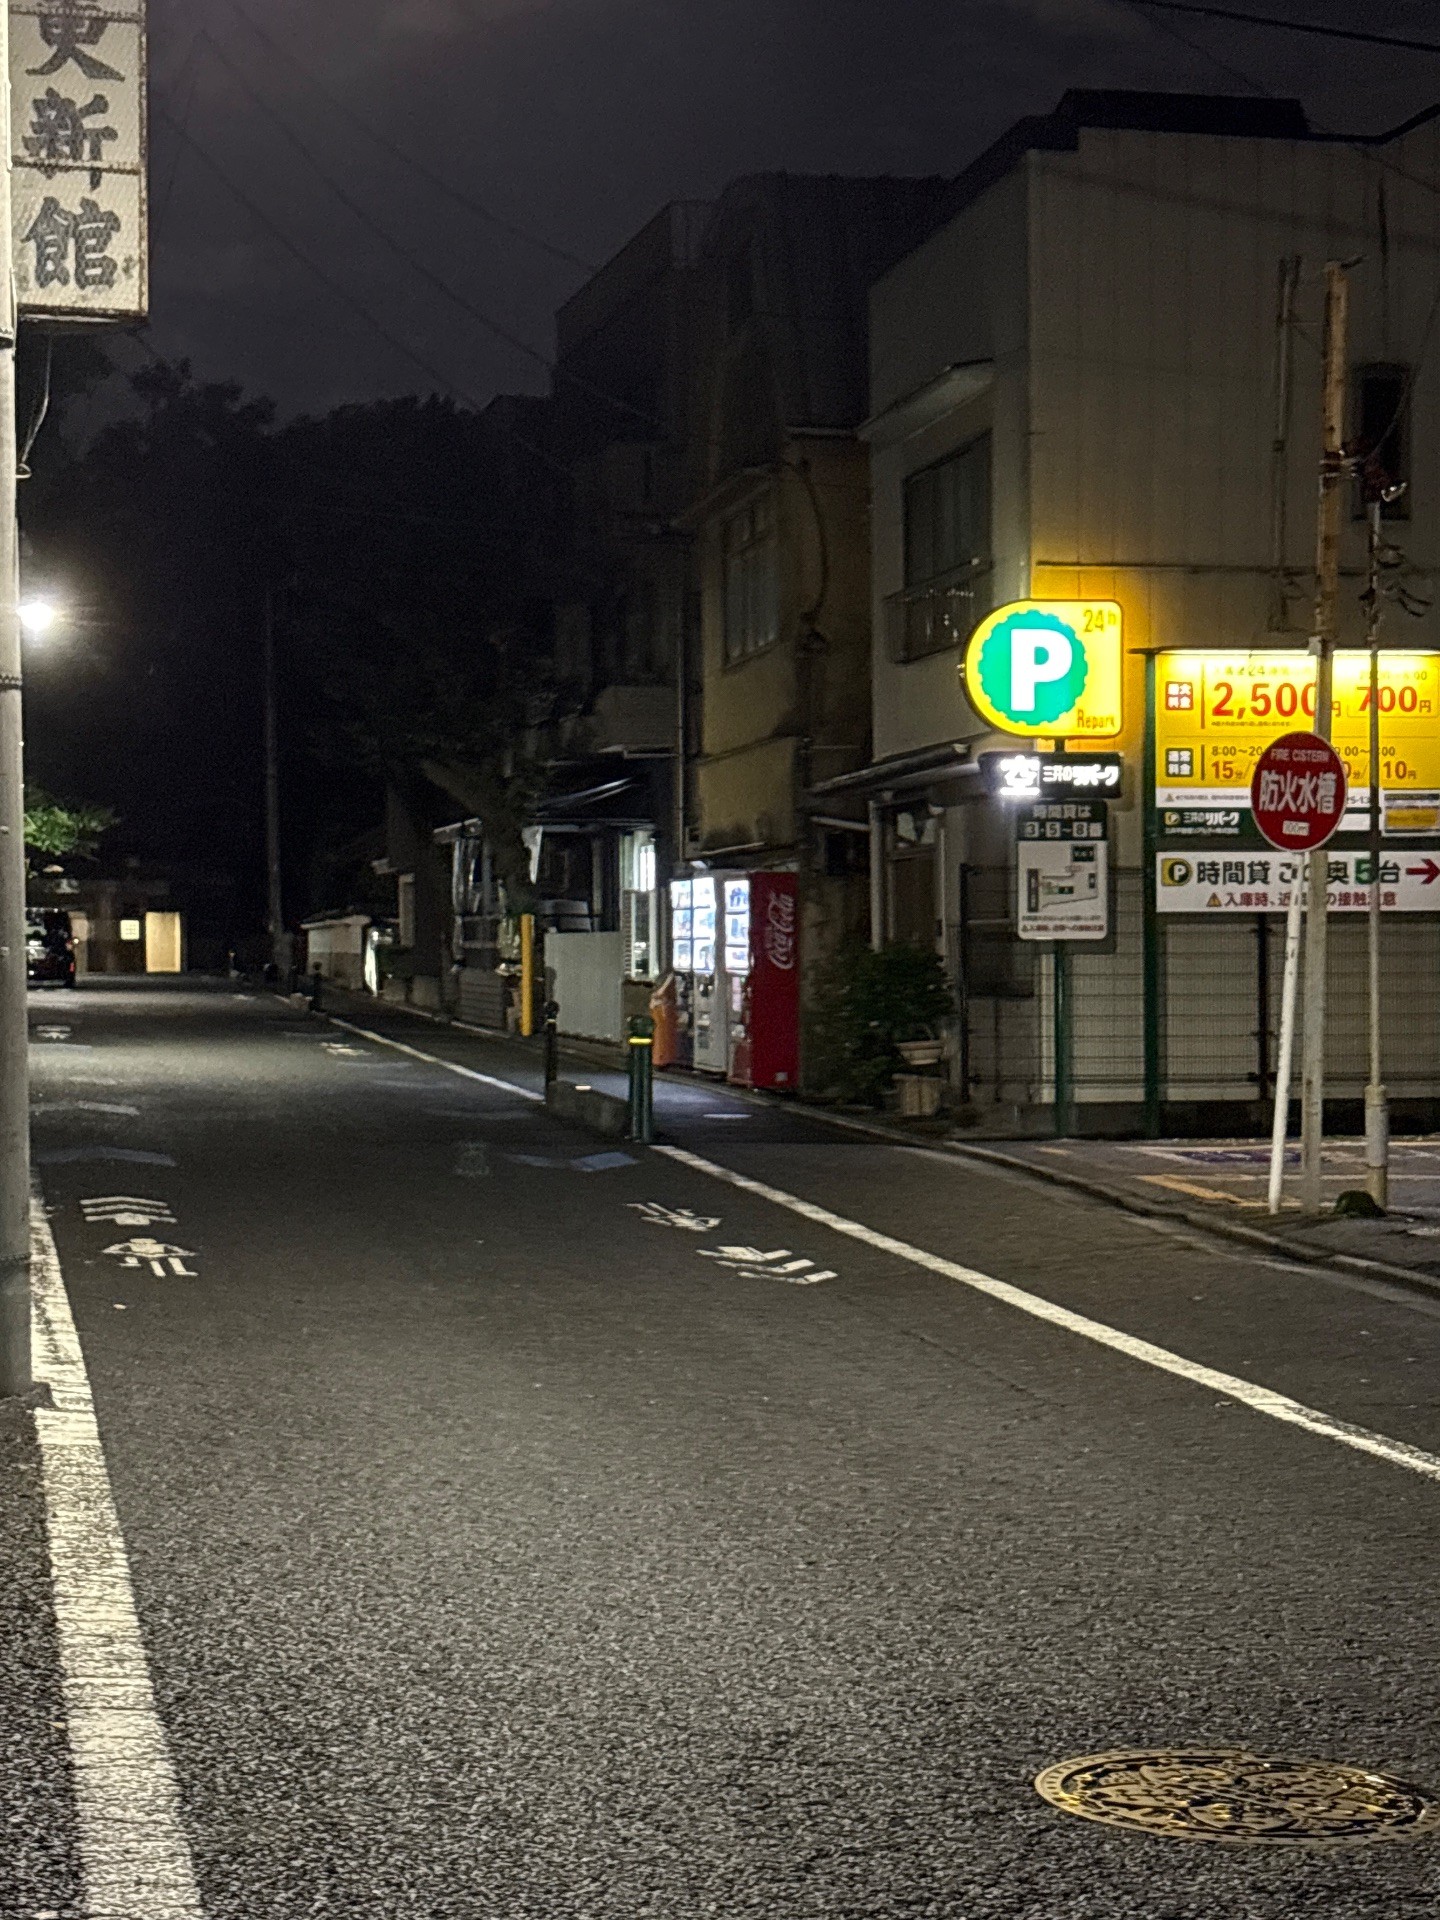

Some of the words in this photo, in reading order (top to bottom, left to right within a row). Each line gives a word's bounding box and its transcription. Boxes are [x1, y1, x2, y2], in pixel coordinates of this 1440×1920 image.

[1010, 628, 1073, 712] P
[1077, 708, 1116, 731] Repark
[999, 754, 1041, 796] 空
[1259, 769, 1337, 815] 防火水槽
[1197, 860, 1271, 886] 時間貸
[764, 891, 796, 971] Coca-Cola
